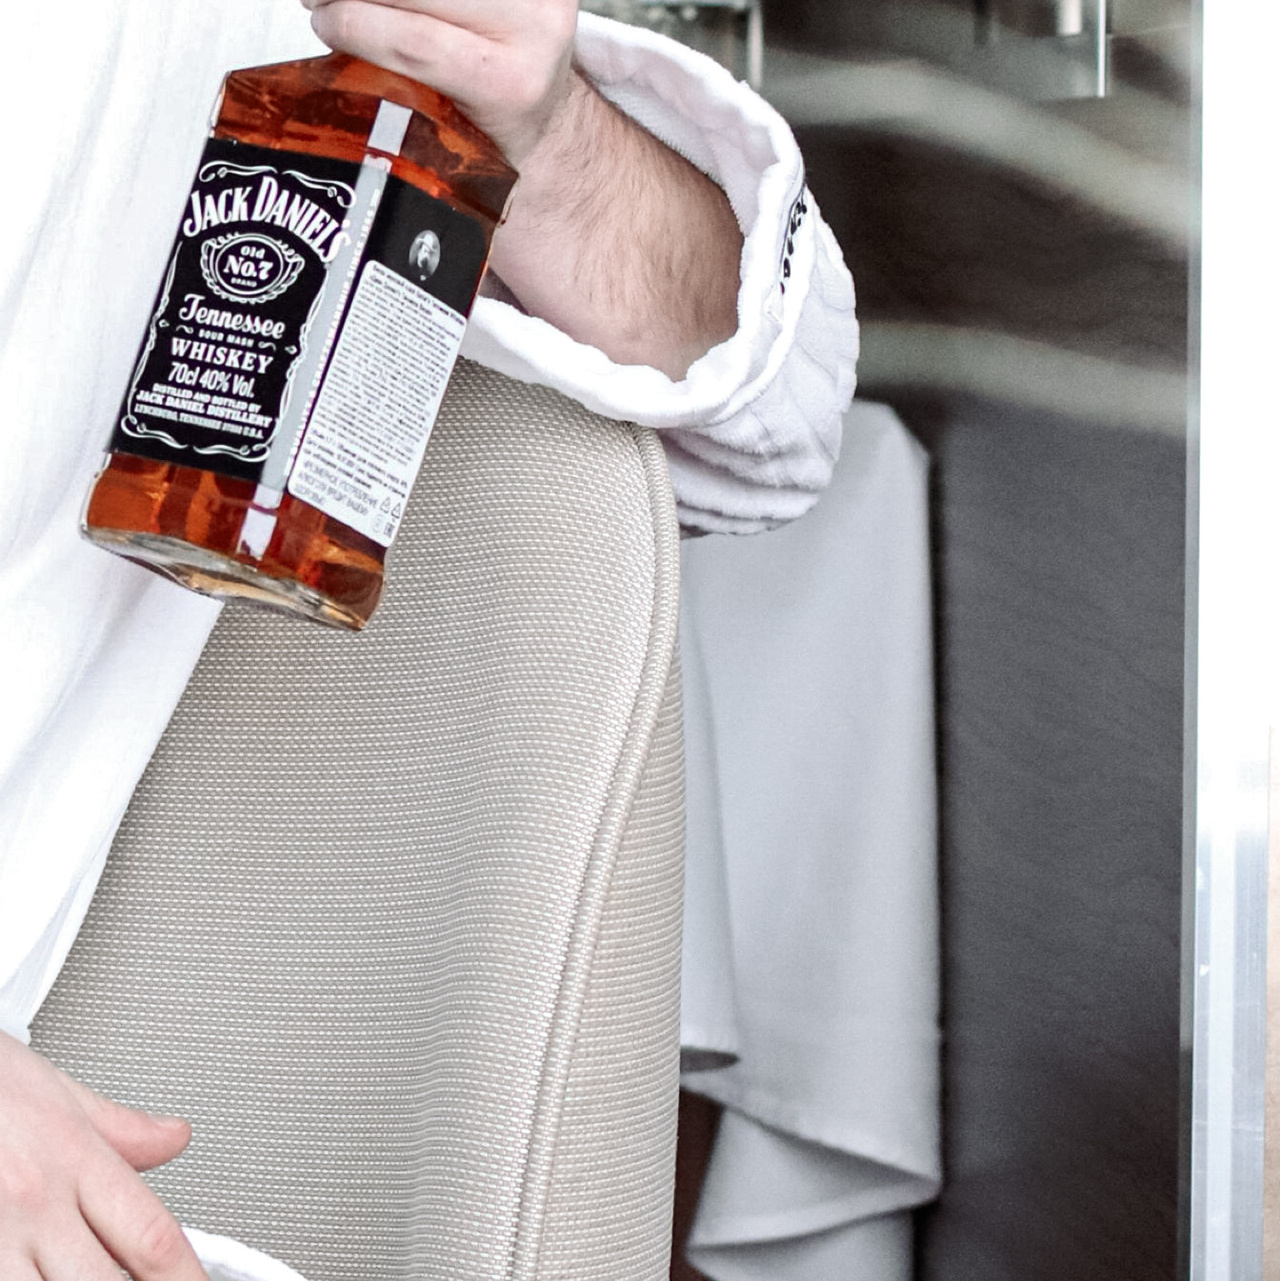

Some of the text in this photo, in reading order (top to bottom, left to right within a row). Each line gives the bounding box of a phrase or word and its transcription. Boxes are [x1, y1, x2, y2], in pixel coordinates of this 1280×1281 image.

[183, 175, 351, 263] JACK DANIEL'S
[240, 245, 266, 259] Old
[230, 277, 258, 288] BRAND
[178, 293, 286, 339] Tennessee
[170, 337, 274, 374] WHISKEY
[198, 329, 255, 347] SOUR MASH
[152, 382, 193, 399] DISTILLED
[193, 391, 211, 403] AND
[211, 395, 248, 411] BOTTLED
[168, 361, 255, 398] 70cl 40% Vol.
[136, 389, 165, 405] JACK
[165, 395, 205, 414] DANIEL
[206, 404, 272, 428] DISTILLERY
